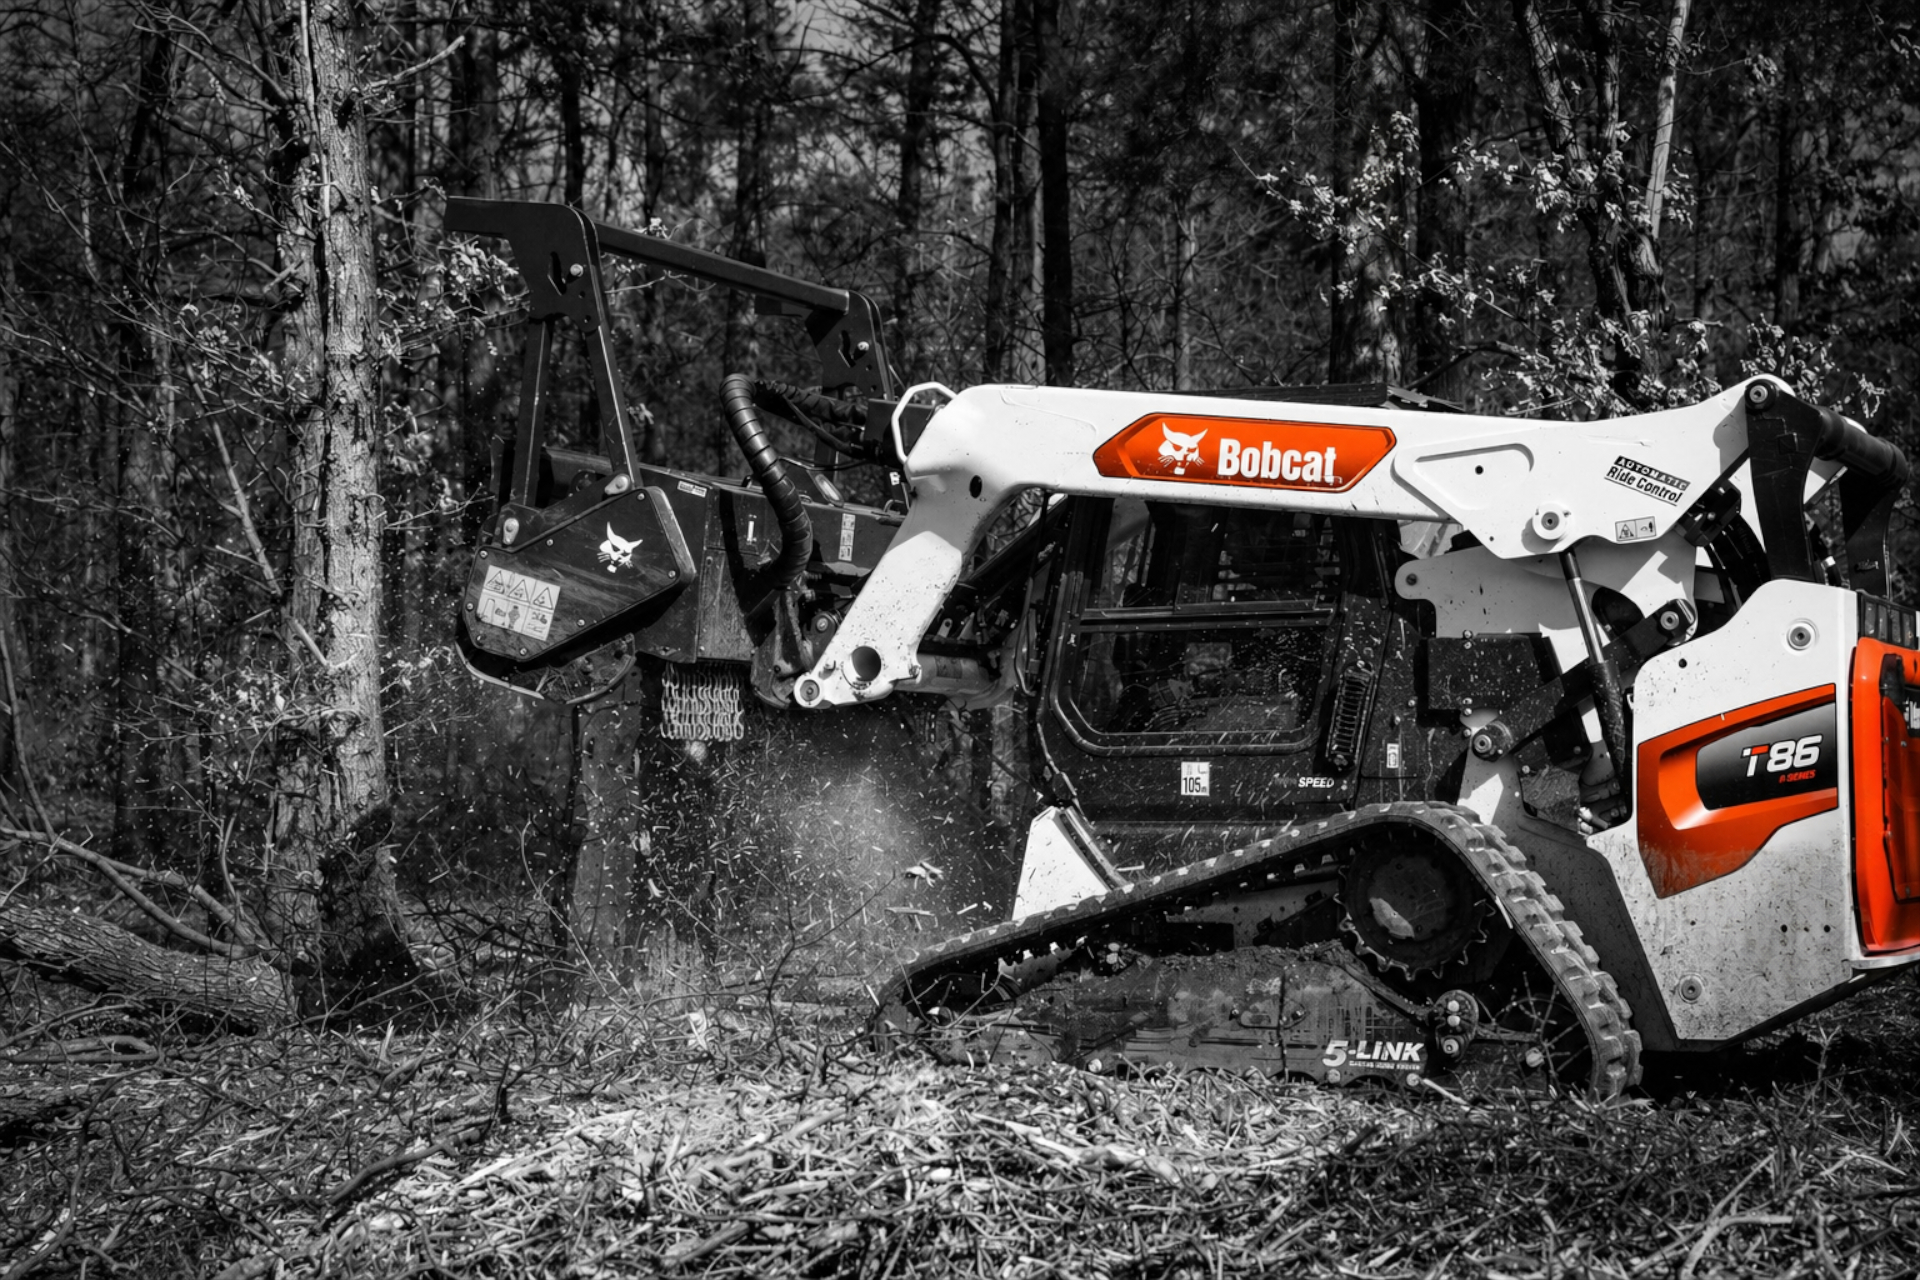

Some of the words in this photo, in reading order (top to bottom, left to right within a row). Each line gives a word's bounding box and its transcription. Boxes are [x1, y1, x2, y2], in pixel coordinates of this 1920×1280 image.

[1217, 438, 1337, 484] Bobcat
[1616, 457, 1690, 491] AUTOMATIC
[1606, 466, 1636, 485] Ride
[1636, 477, 1683, 503] Control
[1742, 734, 1822, 777] T86
[1298, 777, 1335, 789] SPEED
